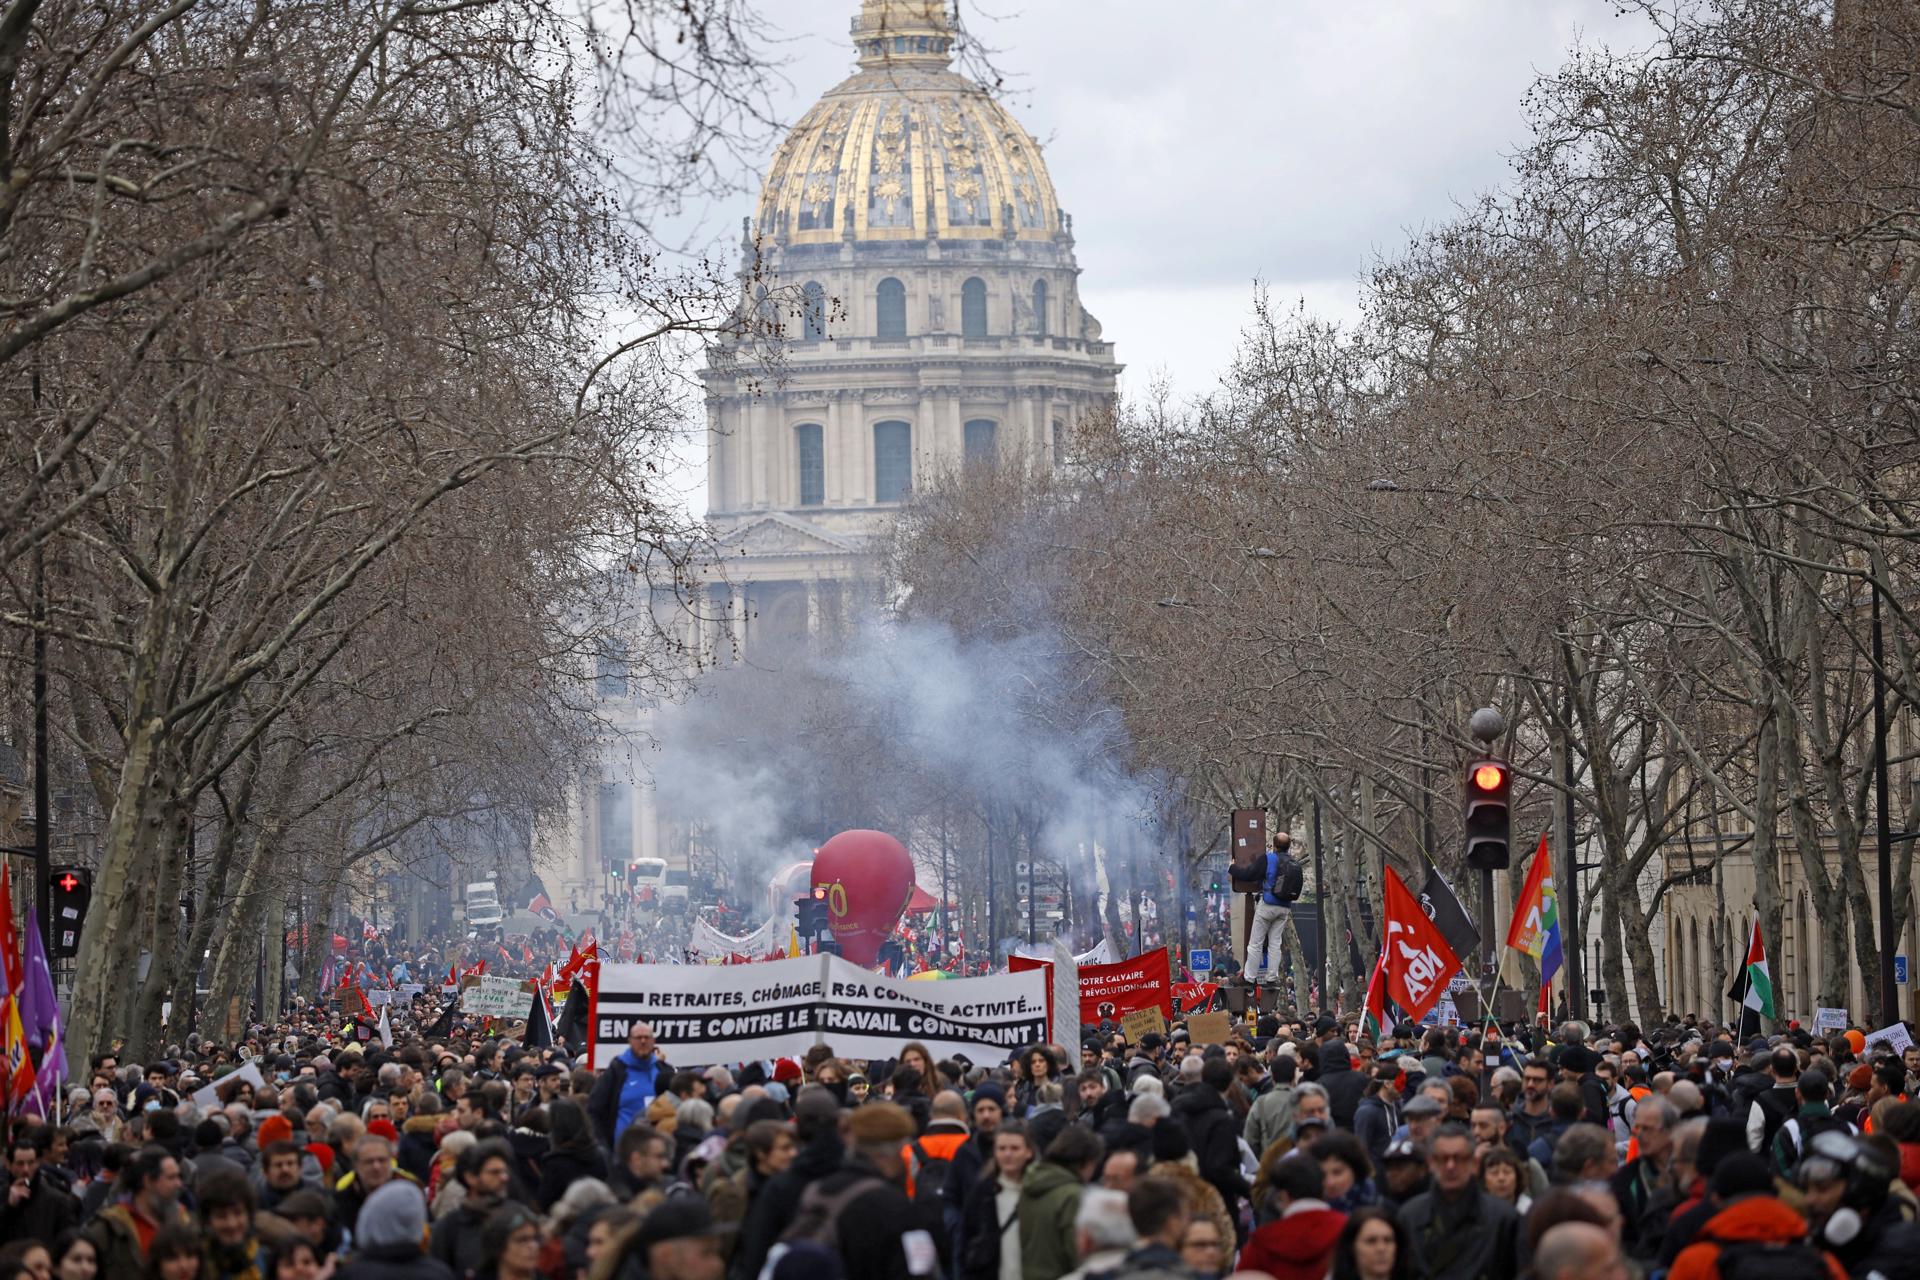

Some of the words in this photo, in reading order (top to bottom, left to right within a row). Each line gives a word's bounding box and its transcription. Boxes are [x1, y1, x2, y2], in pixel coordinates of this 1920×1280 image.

[1085, 981, 1160, 997] RÉVOLUTIONNAIRE
[1106, 971, 1144, 983] CALVAIRE
[648, 991, 747, 1007] RETRAITES,
[752, 982, 827, 1003] CHÔMAGE,
[832, 982, 869, 999] RSA
[874, 986, 945, 1015] CONTRE
[950, 995, 1043, 1017] ACTIVITÉ...
[599, 1019, 629, 1038] EN
[647, 1019, 702, 1038] UTTE
[706, 1012, 784, 1038] CONTRE
[788, 1009, 809, 1028] LE
[815, 1008, 902, 1032] TRAVAIL
[908, 1015, 1032, 1045] CONTRAINT
[1037, 1023, 1044, 1042] !
